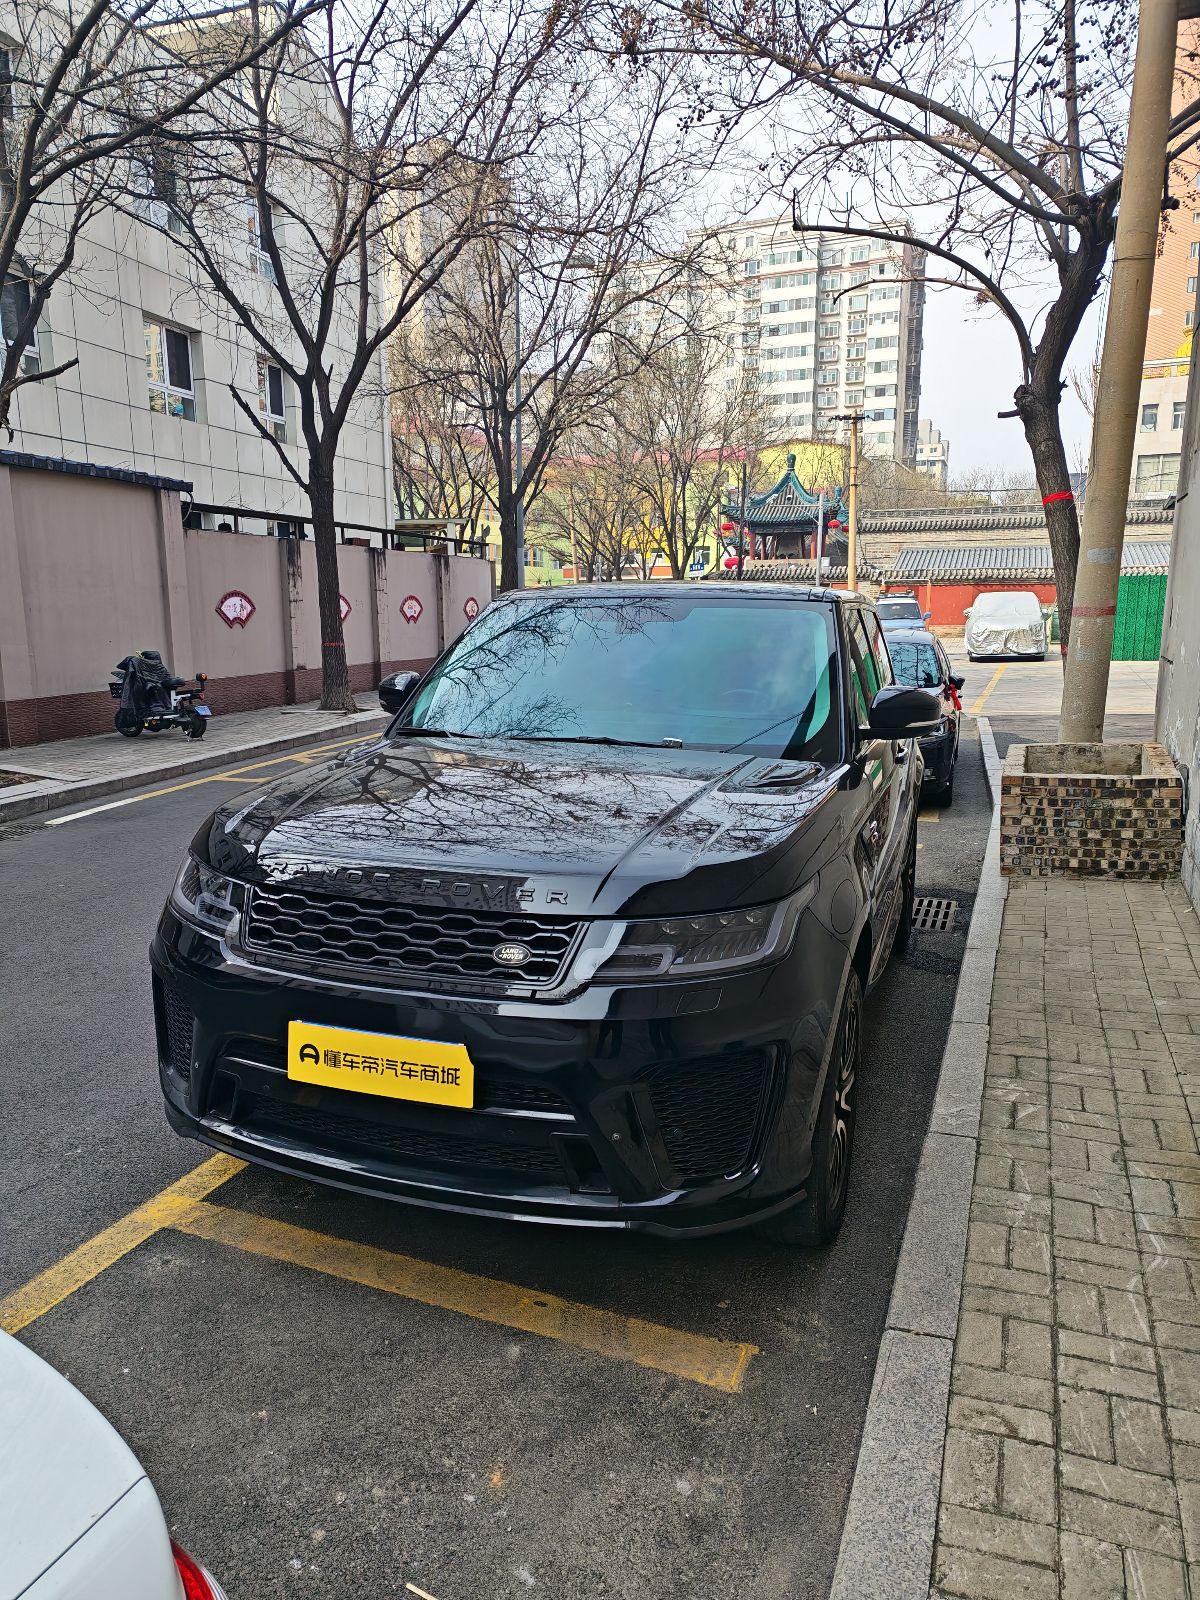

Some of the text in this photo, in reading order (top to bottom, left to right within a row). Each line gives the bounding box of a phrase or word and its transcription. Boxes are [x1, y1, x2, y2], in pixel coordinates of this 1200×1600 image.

[269, 861, 569, 905] RANGE ROVER
[323, 1049, 460, 1086] 懂车帝汽车商城
